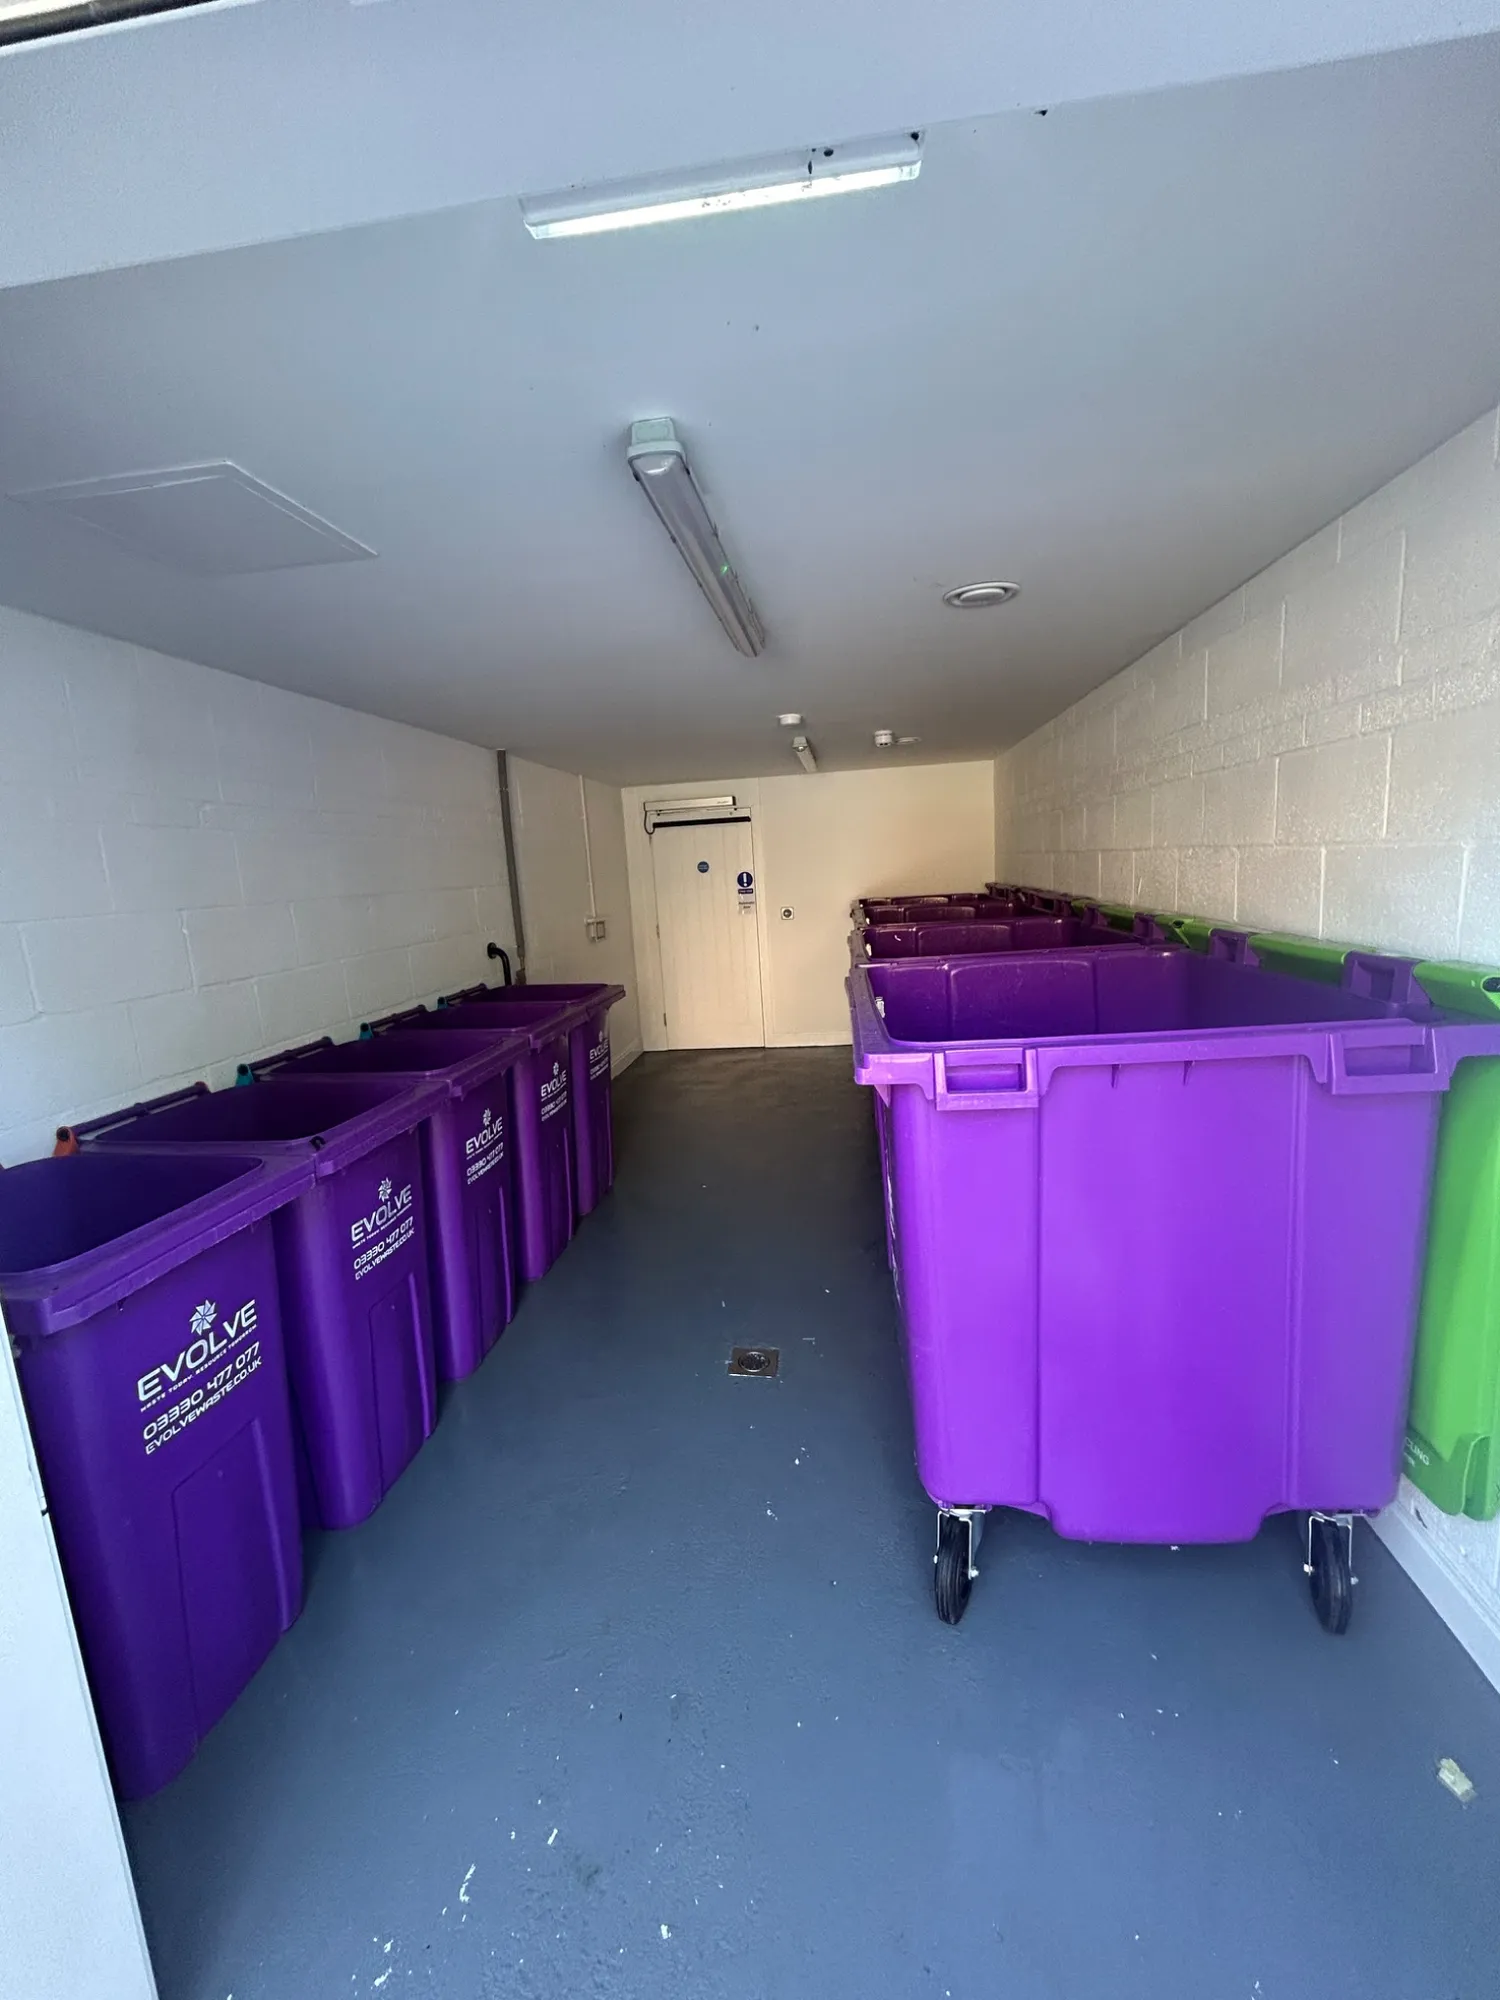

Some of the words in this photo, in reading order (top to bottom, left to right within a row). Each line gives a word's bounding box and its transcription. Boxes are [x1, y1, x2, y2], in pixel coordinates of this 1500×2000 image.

[466, 1116, 503, 1155] EVOLVE
[351, 1183, 412, 1242] EVOLVE
[353, 1241, 385, 1270] 03330
[386, 1228, 399, 1243] 477
[400, 1216, 413, 1234] 077
[137, 1299, 257, 1401] EVOLVE
[140, 1393, 166, 1412] WASTE
[195, 1349, 227, 1375] RESOURCE
[143, 1389, 204, 1440] 03330
[206, 1363, 233, 1391] 477
[235, 1341, 260, 1369] 077
[145, 1356, 263, 1455] EVOLVEWASTE.CO.UK
